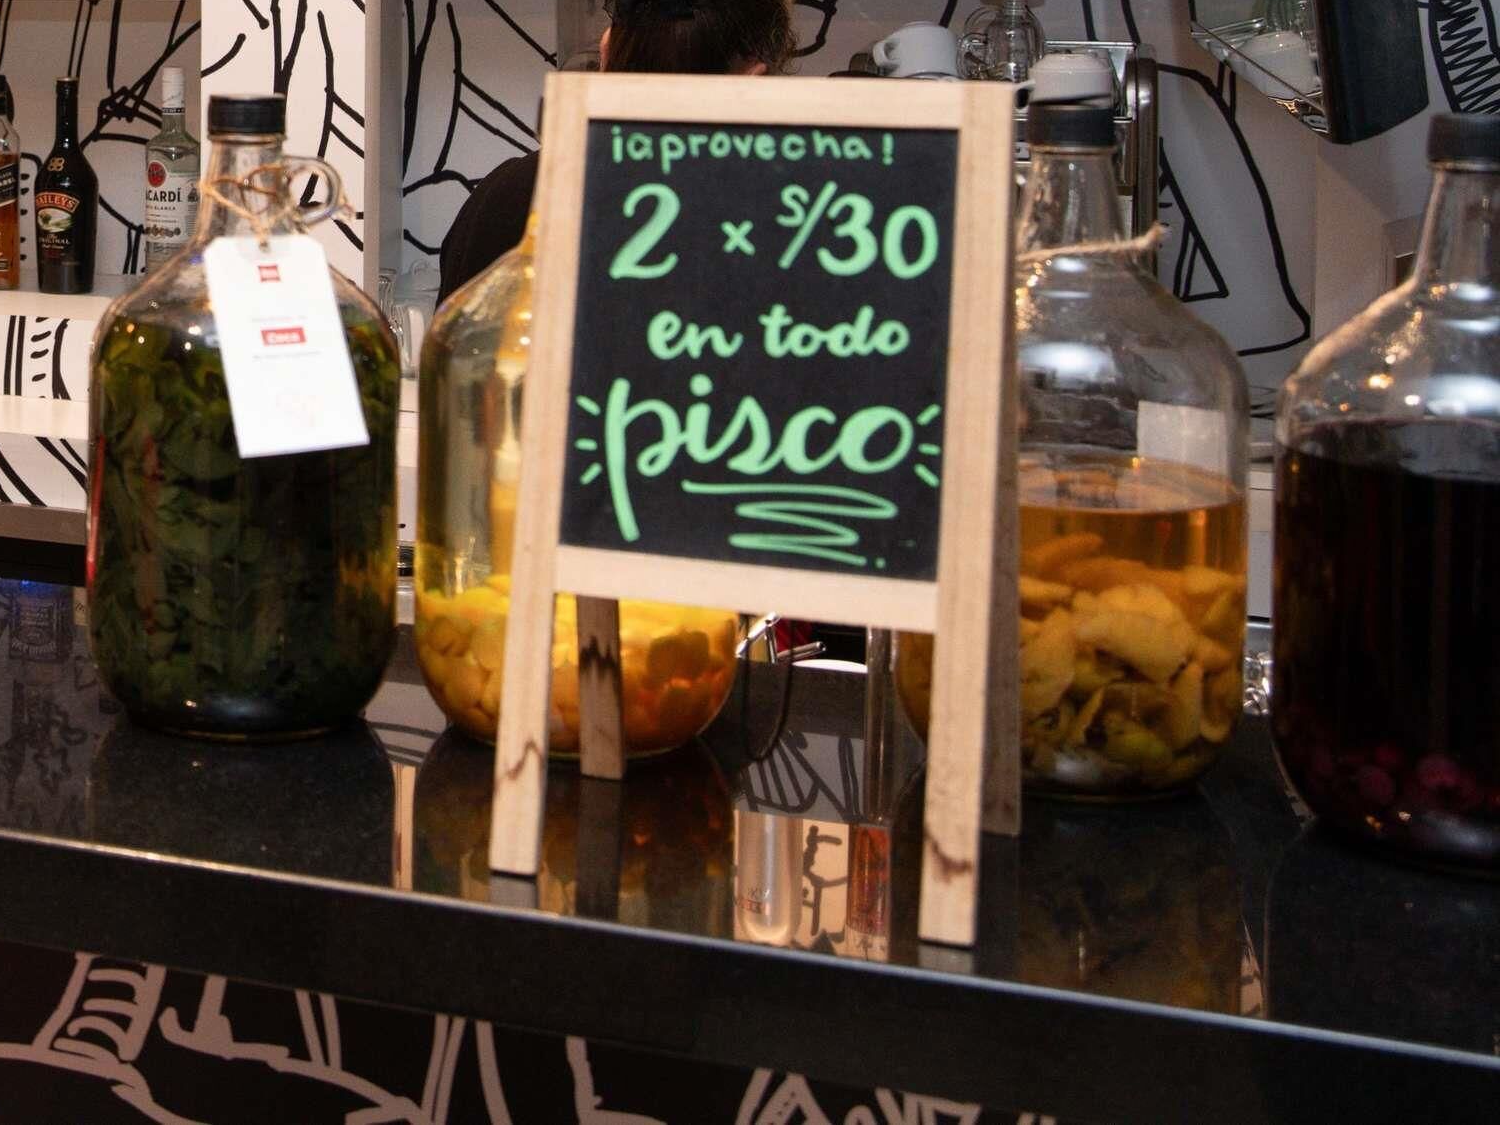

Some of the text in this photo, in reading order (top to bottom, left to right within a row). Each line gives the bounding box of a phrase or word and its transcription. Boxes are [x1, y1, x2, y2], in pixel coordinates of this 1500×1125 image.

[147, 187, 182, 203] CARDÍ
[609, 180, 939, 279] 2 x S/30
[647, 303, 910, 360] en todo
[605, 374, 914, 543] pisco
